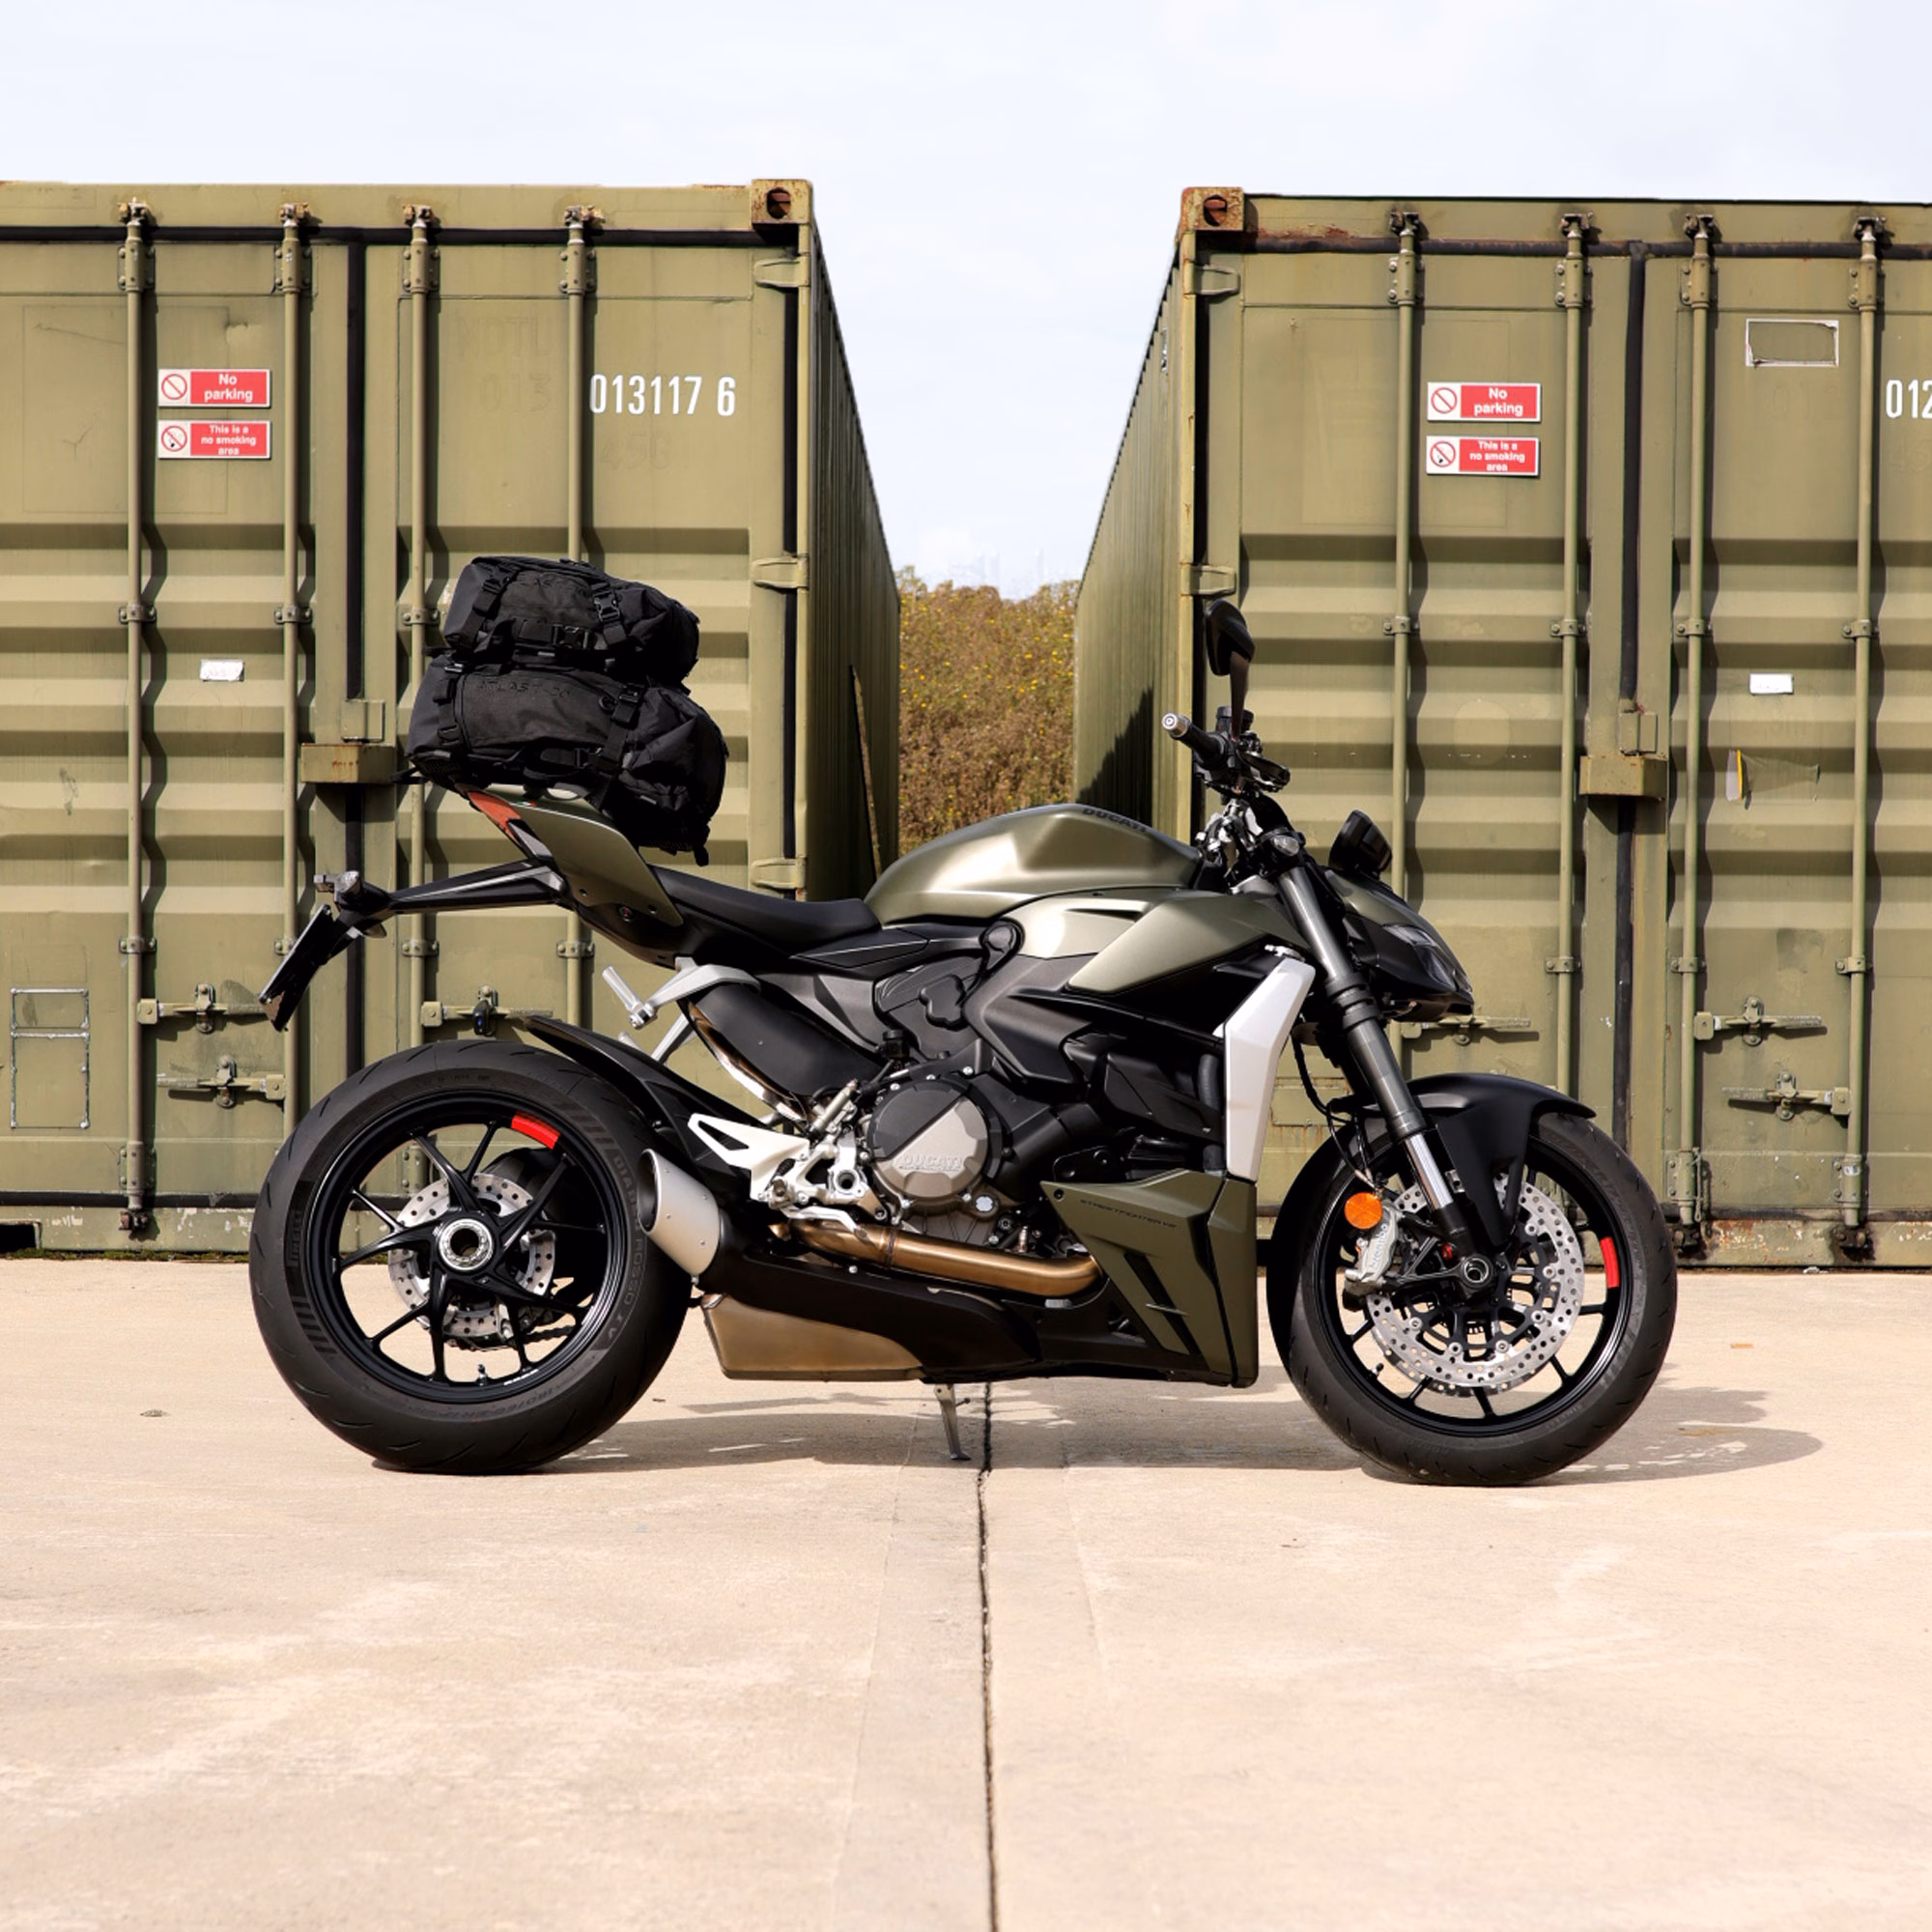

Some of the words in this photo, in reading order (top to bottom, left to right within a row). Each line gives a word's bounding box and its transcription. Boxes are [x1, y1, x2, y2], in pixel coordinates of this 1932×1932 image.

[218, 374, 238, 385] No
[204, 388, 253, 403] parking
[589, 374, 702, 415] 013117
[717, 376, 736, 416] 6
[1489, 387, 1508, 400] No
[1886, 379, 1932, 419] 012
[1473, 402, 1523, 417] parking
[210, 425, 230, 434] This
[232, 425, 241, 434] is
[215, 436, 256, 447] smoking
[1477, 440, 1498, 450] This
[1500, 441, 1509, 450] is
[218, 447, 240, 456] area
[1484, 452, 1525, 464] smoking
[623, 1238, 644, 1305] ROSSO
